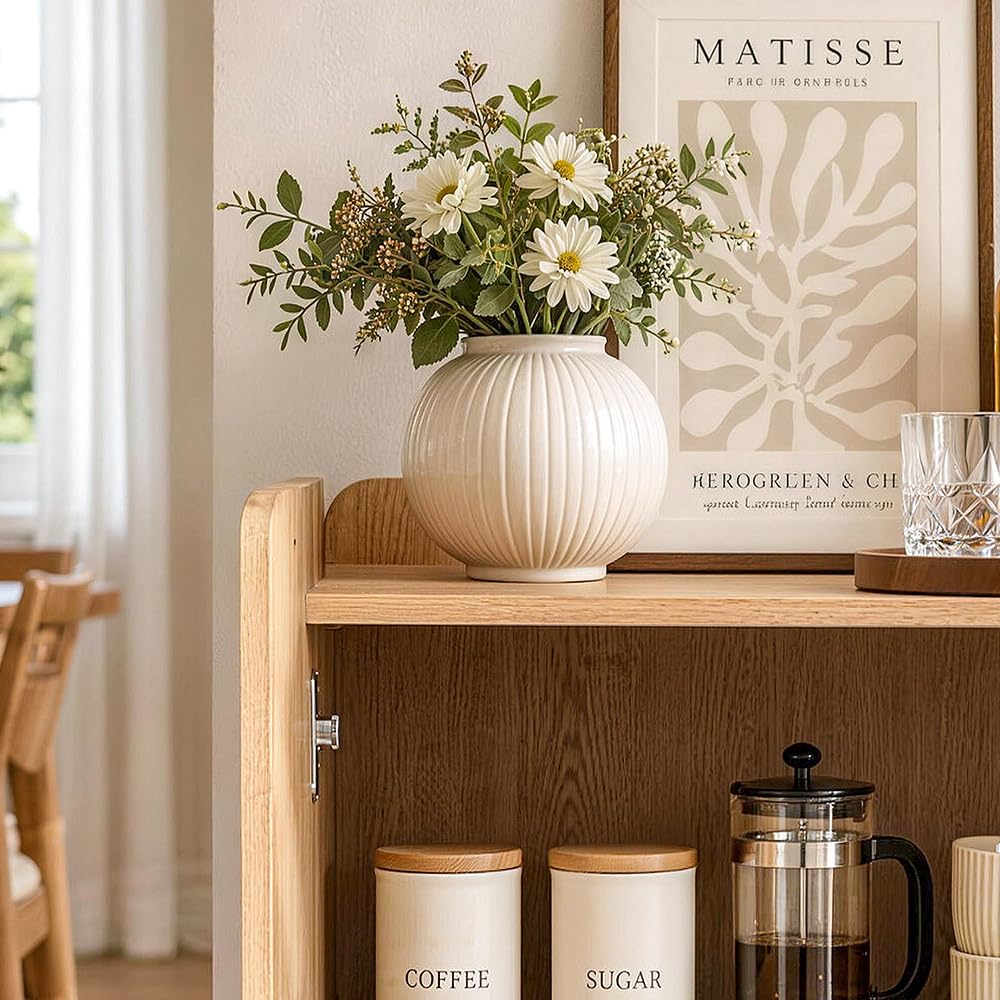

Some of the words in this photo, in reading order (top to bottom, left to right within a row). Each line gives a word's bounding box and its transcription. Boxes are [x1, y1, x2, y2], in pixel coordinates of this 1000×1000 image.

[693, 38, 904, 66] MATISSE
[841, 473, 855, 489] &
[404, 968, 491, 990] COFFEE
[585, 969, 663, 990] SUGAR
